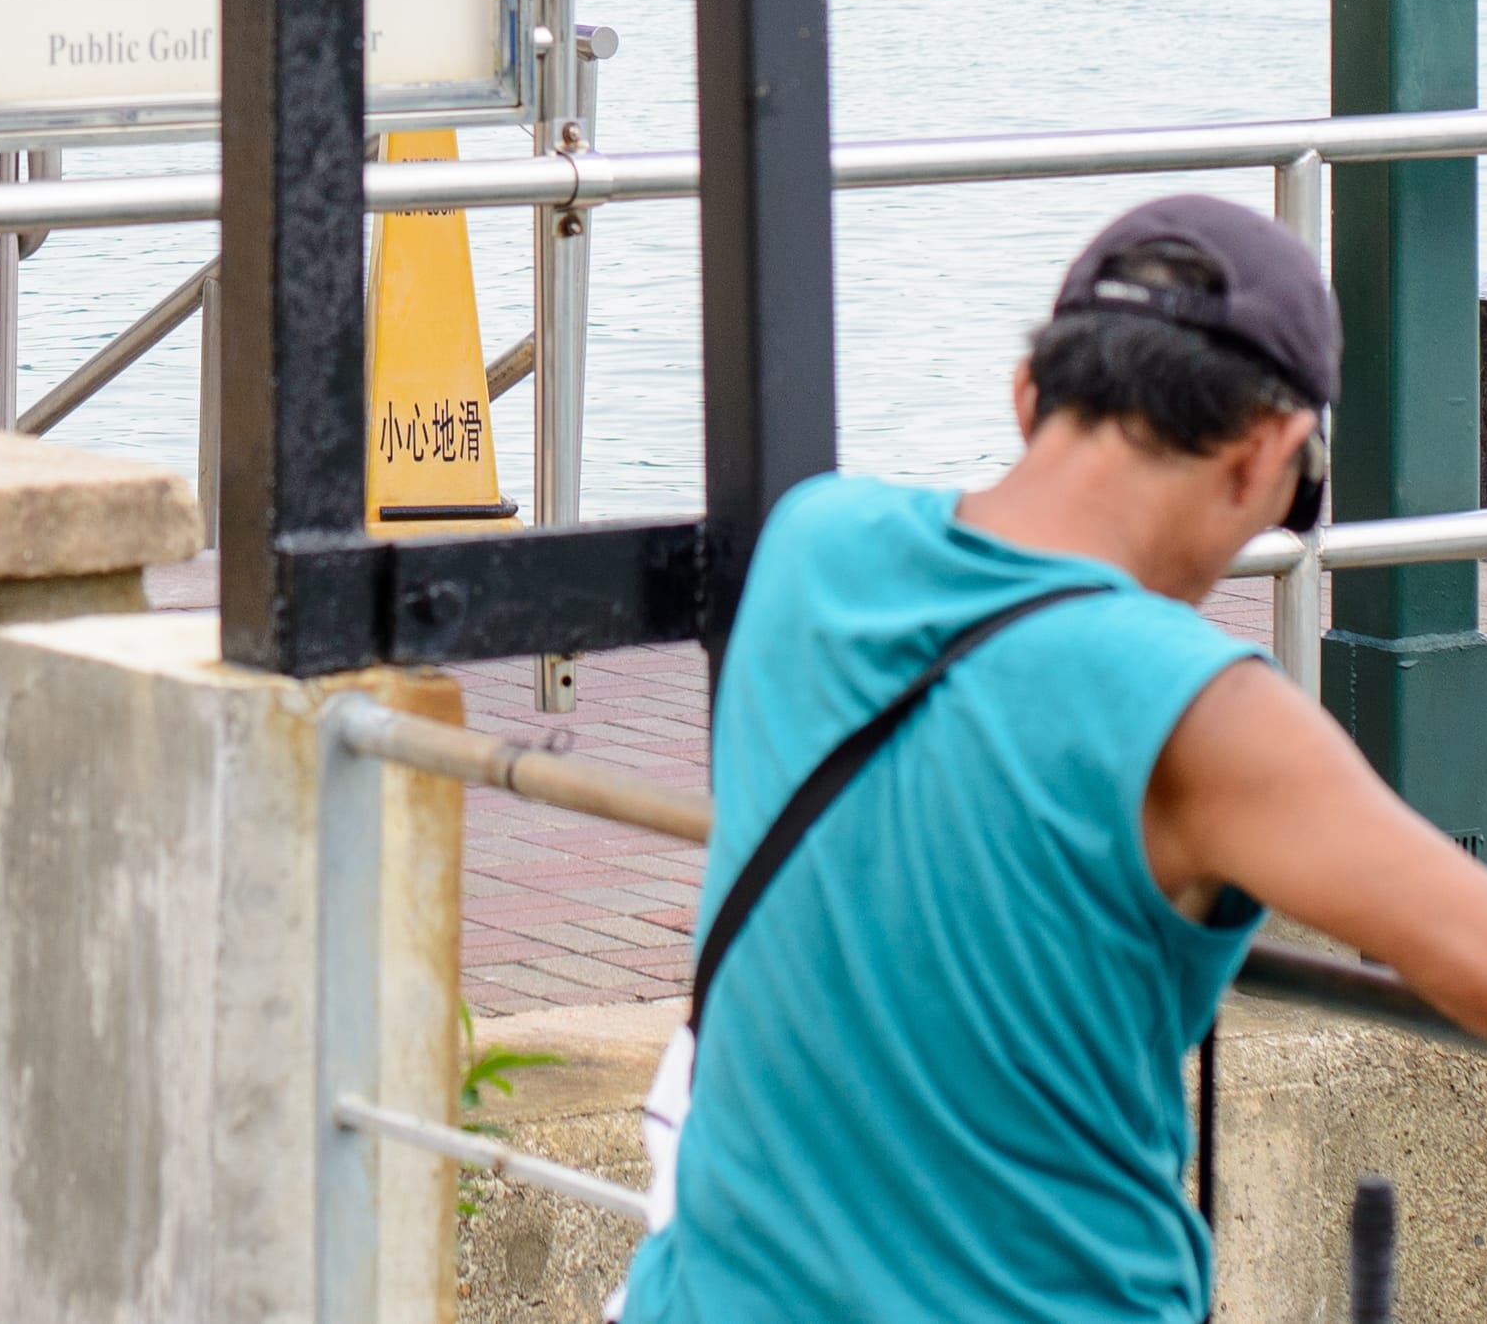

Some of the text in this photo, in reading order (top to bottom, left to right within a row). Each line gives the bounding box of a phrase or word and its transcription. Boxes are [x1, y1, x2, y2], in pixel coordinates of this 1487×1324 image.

[47, 26, 213, 67] Public Golf
[379, 398, 483, 463] 小心地滑
